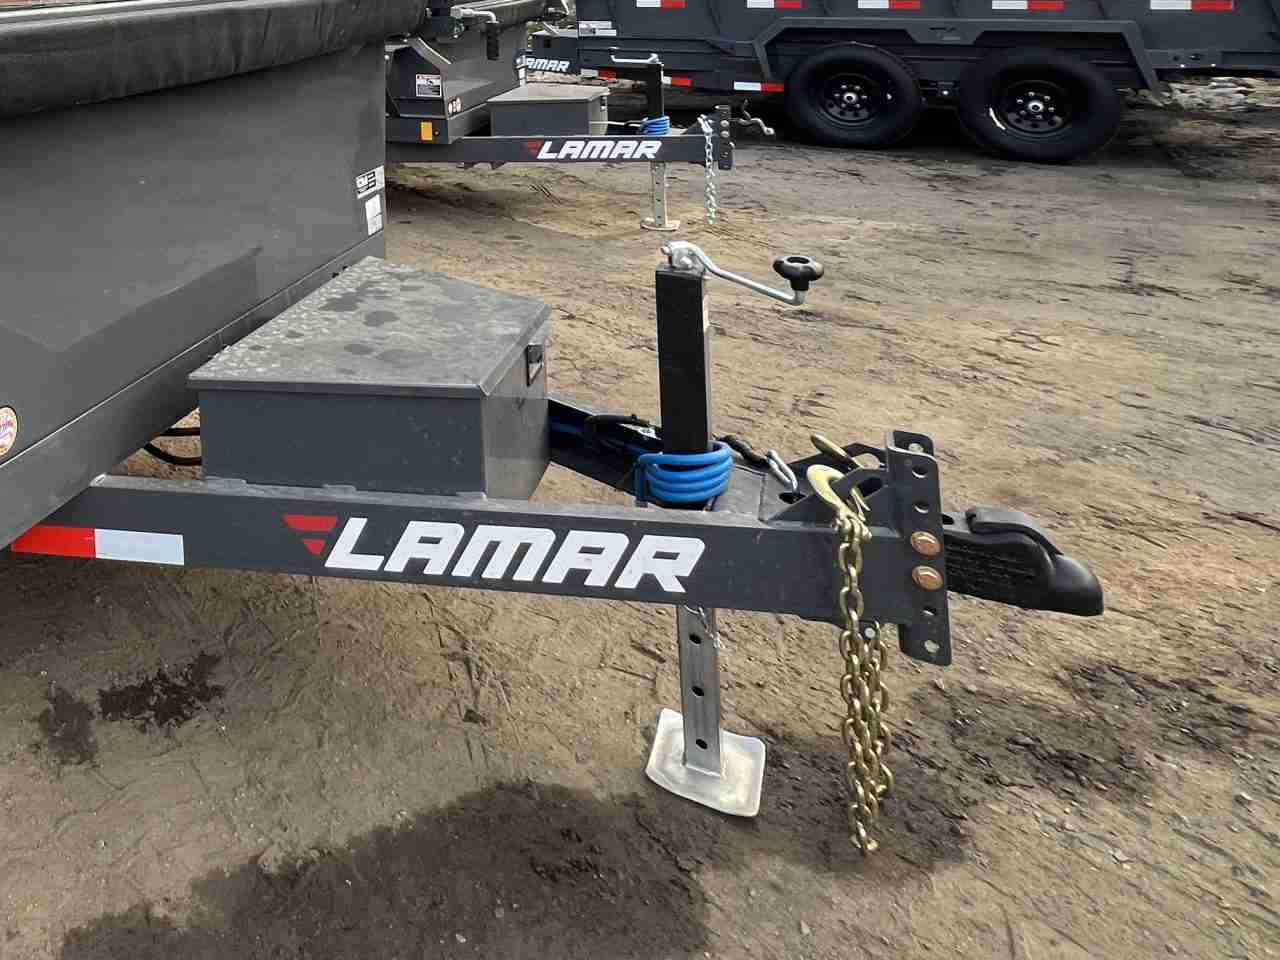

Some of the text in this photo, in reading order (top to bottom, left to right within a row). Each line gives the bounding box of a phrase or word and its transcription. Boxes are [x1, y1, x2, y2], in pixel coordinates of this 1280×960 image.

[524, 57, 570, 72] AMAR
[536, 140, 663, 160] LAMAR
[323, 516, 706, 594] LAMAR
